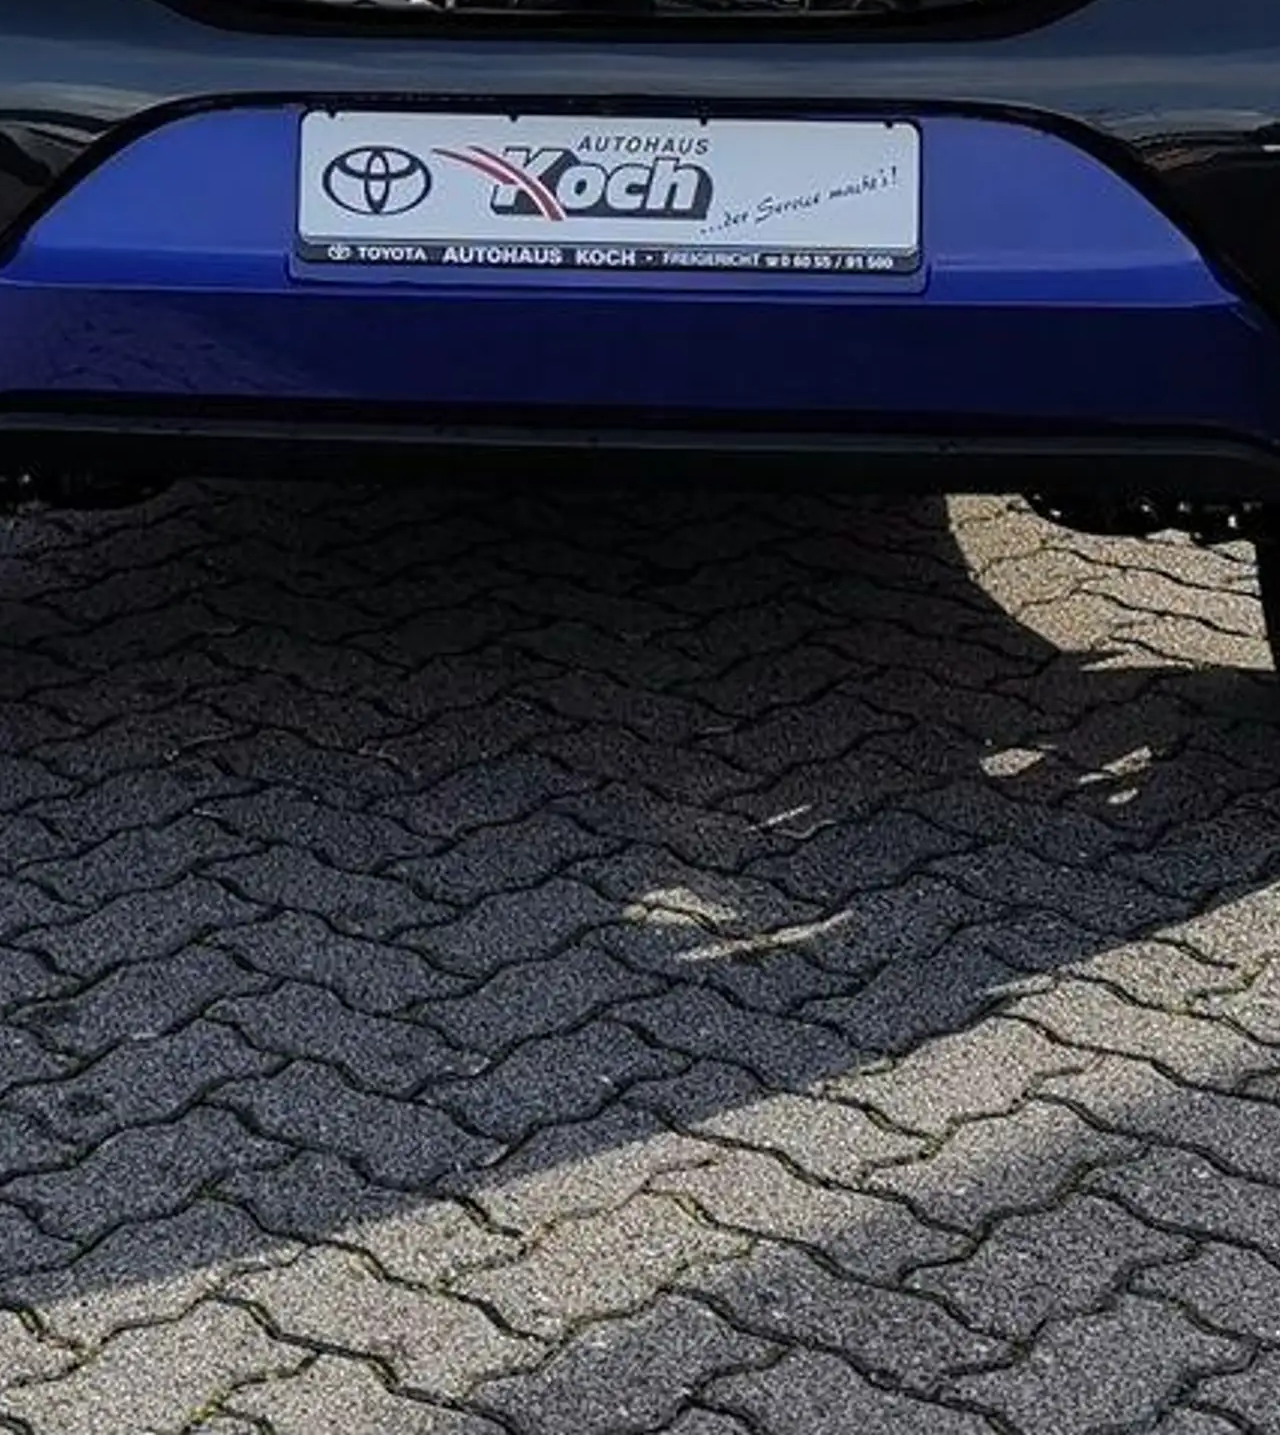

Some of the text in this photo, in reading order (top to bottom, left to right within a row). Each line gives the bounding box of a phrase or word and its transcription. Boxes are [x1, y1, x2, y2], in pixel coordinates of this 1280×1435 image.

[577, 135, 710, 156] AUTOHAUS
[490, 146, 714, 220] Koch
[754, 194, 823, 226] Service
[358, 246, 427, 261] TOYOTA
[442, 245, 563, 265] AUTOHAUS
[575, 248, 636, 266] KOCH
